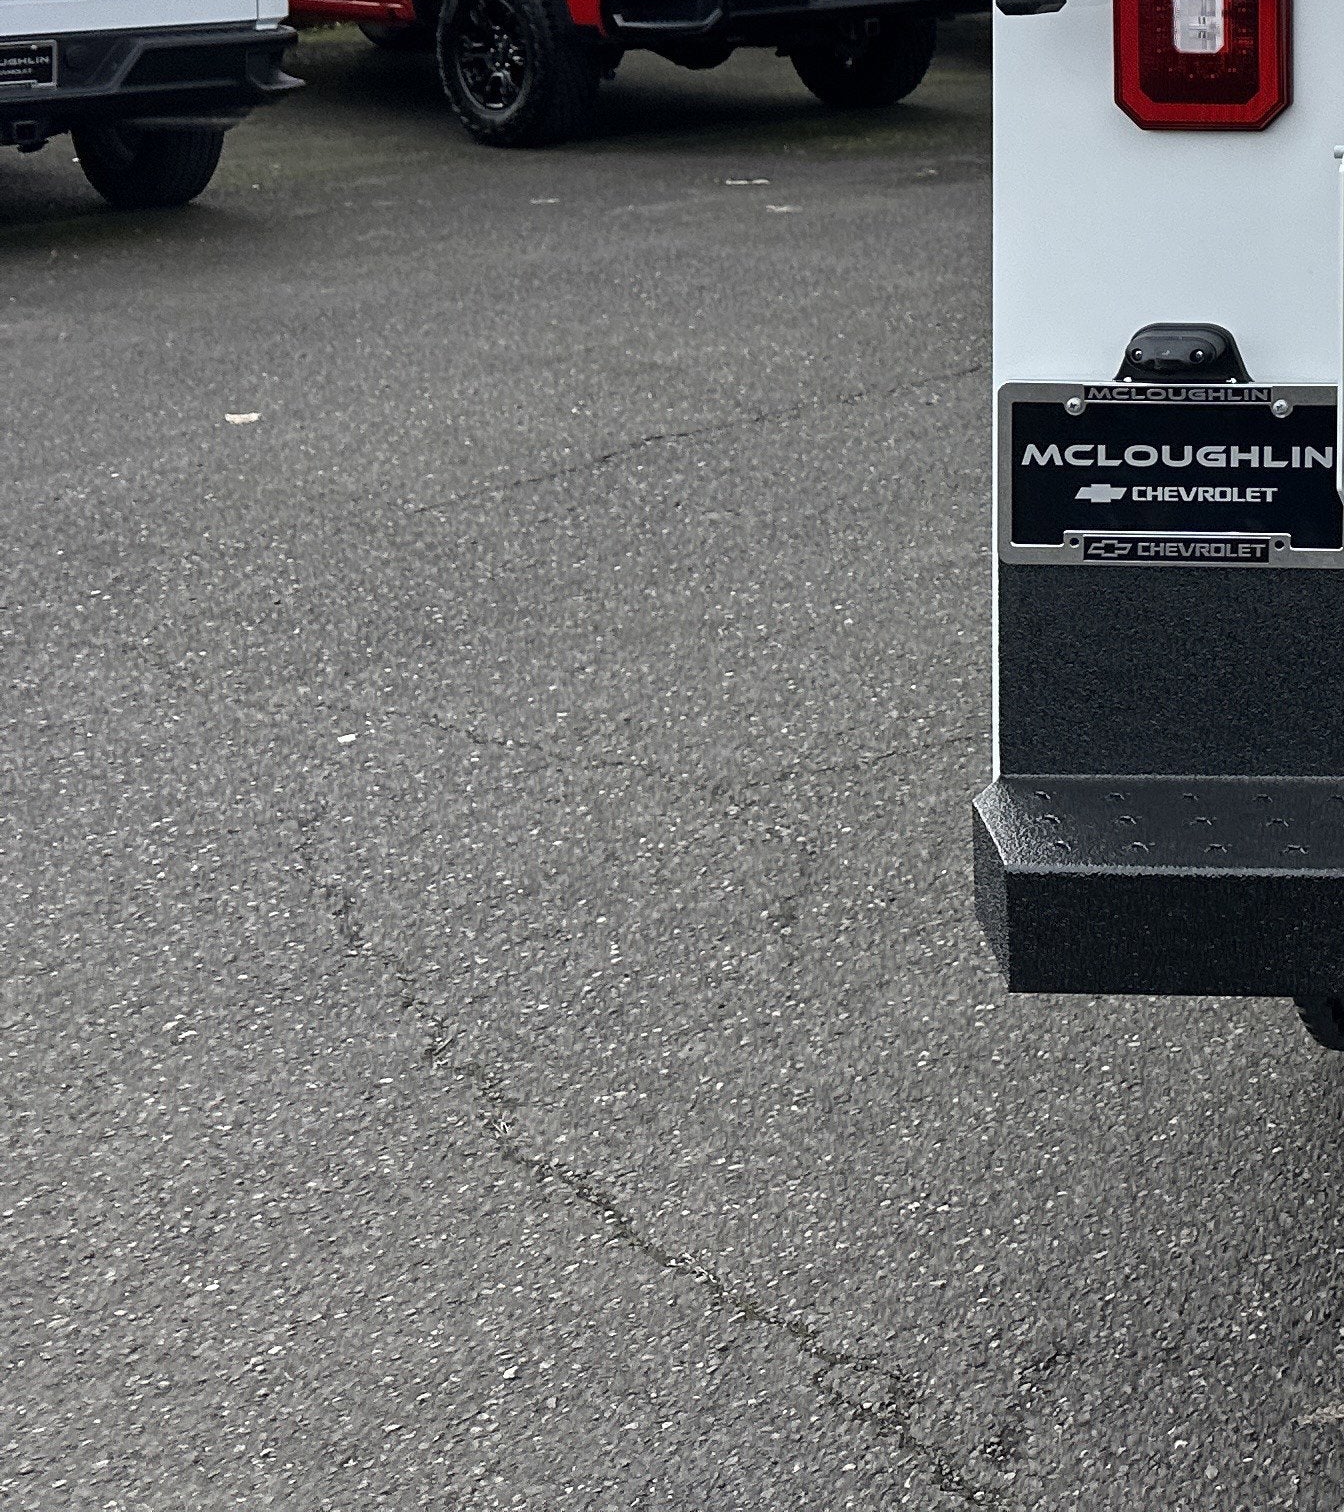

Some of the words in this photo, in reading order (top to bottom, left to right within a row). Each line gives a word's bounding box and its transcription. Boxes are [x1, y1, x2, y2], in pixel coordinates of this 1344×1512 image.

[1086, 387, 1269, 402] MCLOUGHLIN
[1020, 443, 1334, 469] MCLOUGHLIN
[1131, 486, 1279, 503] CHEVROLET
[1137, 541, 1267, 558] CHEVROLET
